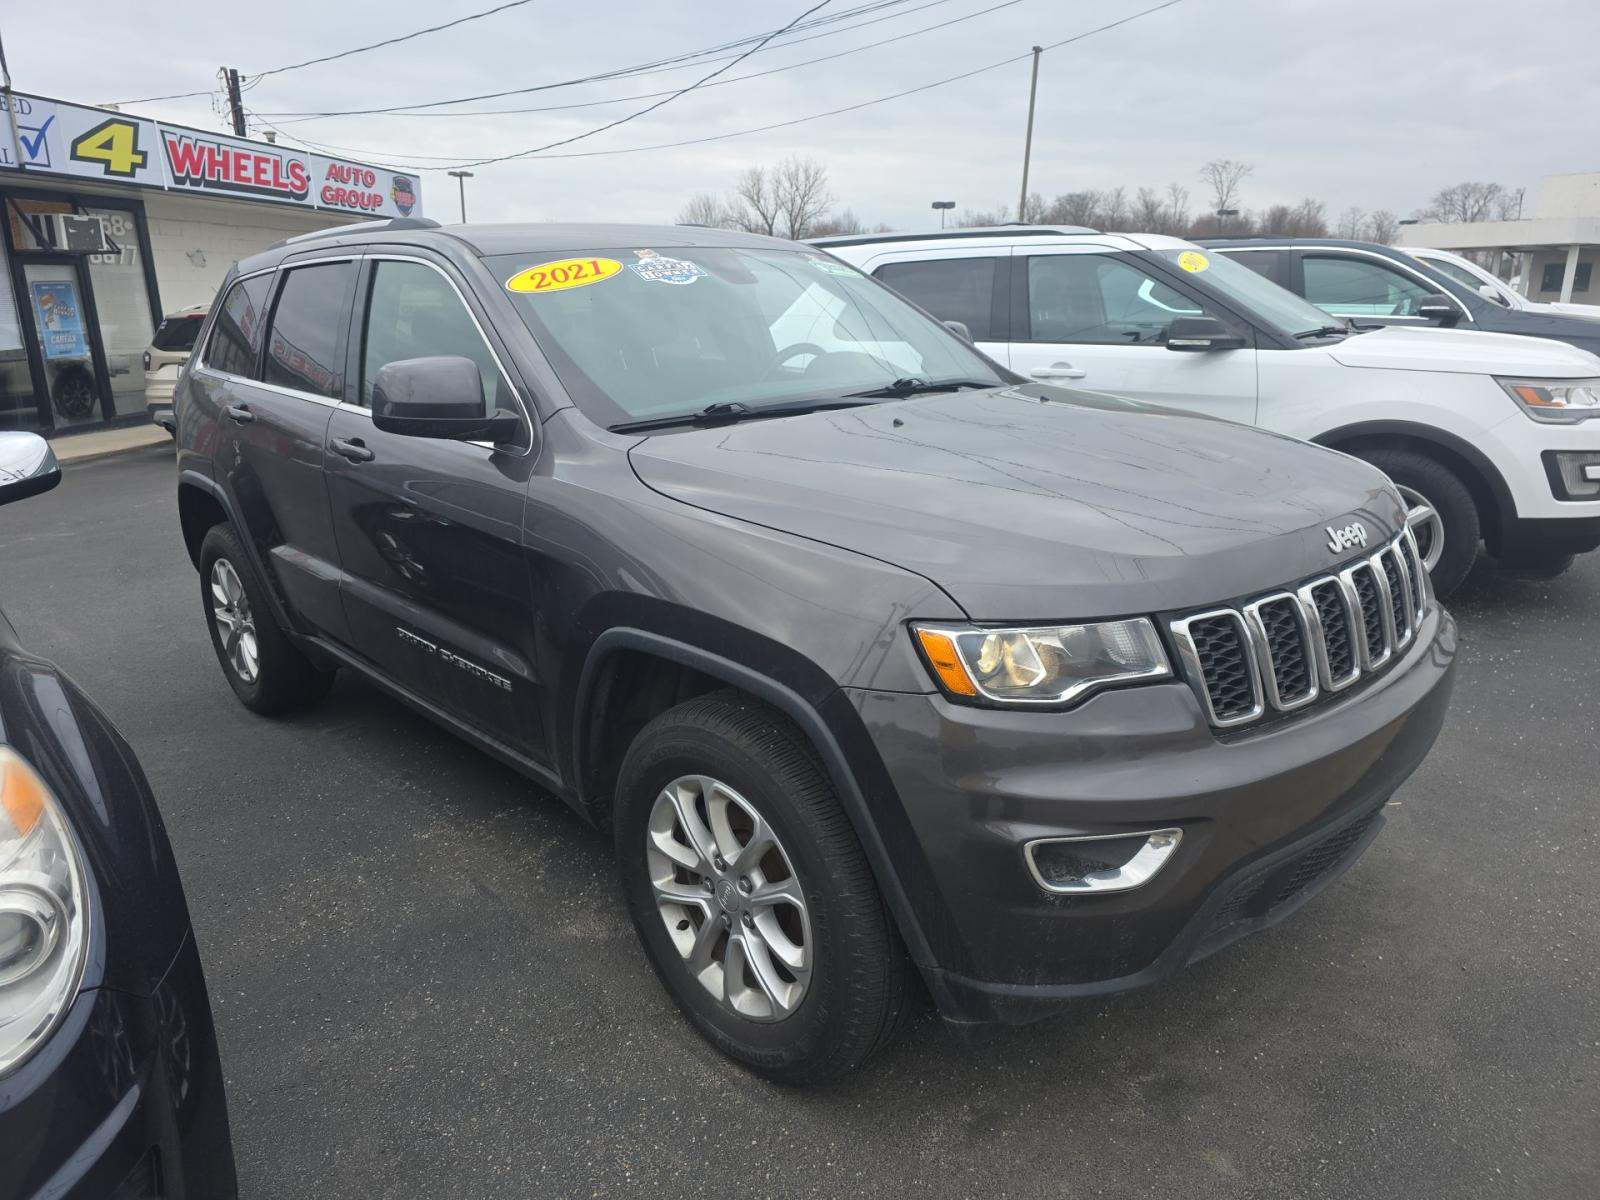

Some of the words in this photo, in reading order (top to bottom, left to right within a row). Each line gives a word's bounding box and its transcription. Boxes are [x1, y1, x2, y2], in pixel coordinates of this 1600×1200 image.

[70, 118, 148, 178] 4
[163, 133, 310, 200] WHEELS
[325, 163, 376, 188] AUTO
[321, 185, 384, 211] GROUP
[530, 260, 606, 289] 2021
[1325, 522, 1368, 554] Jeep
